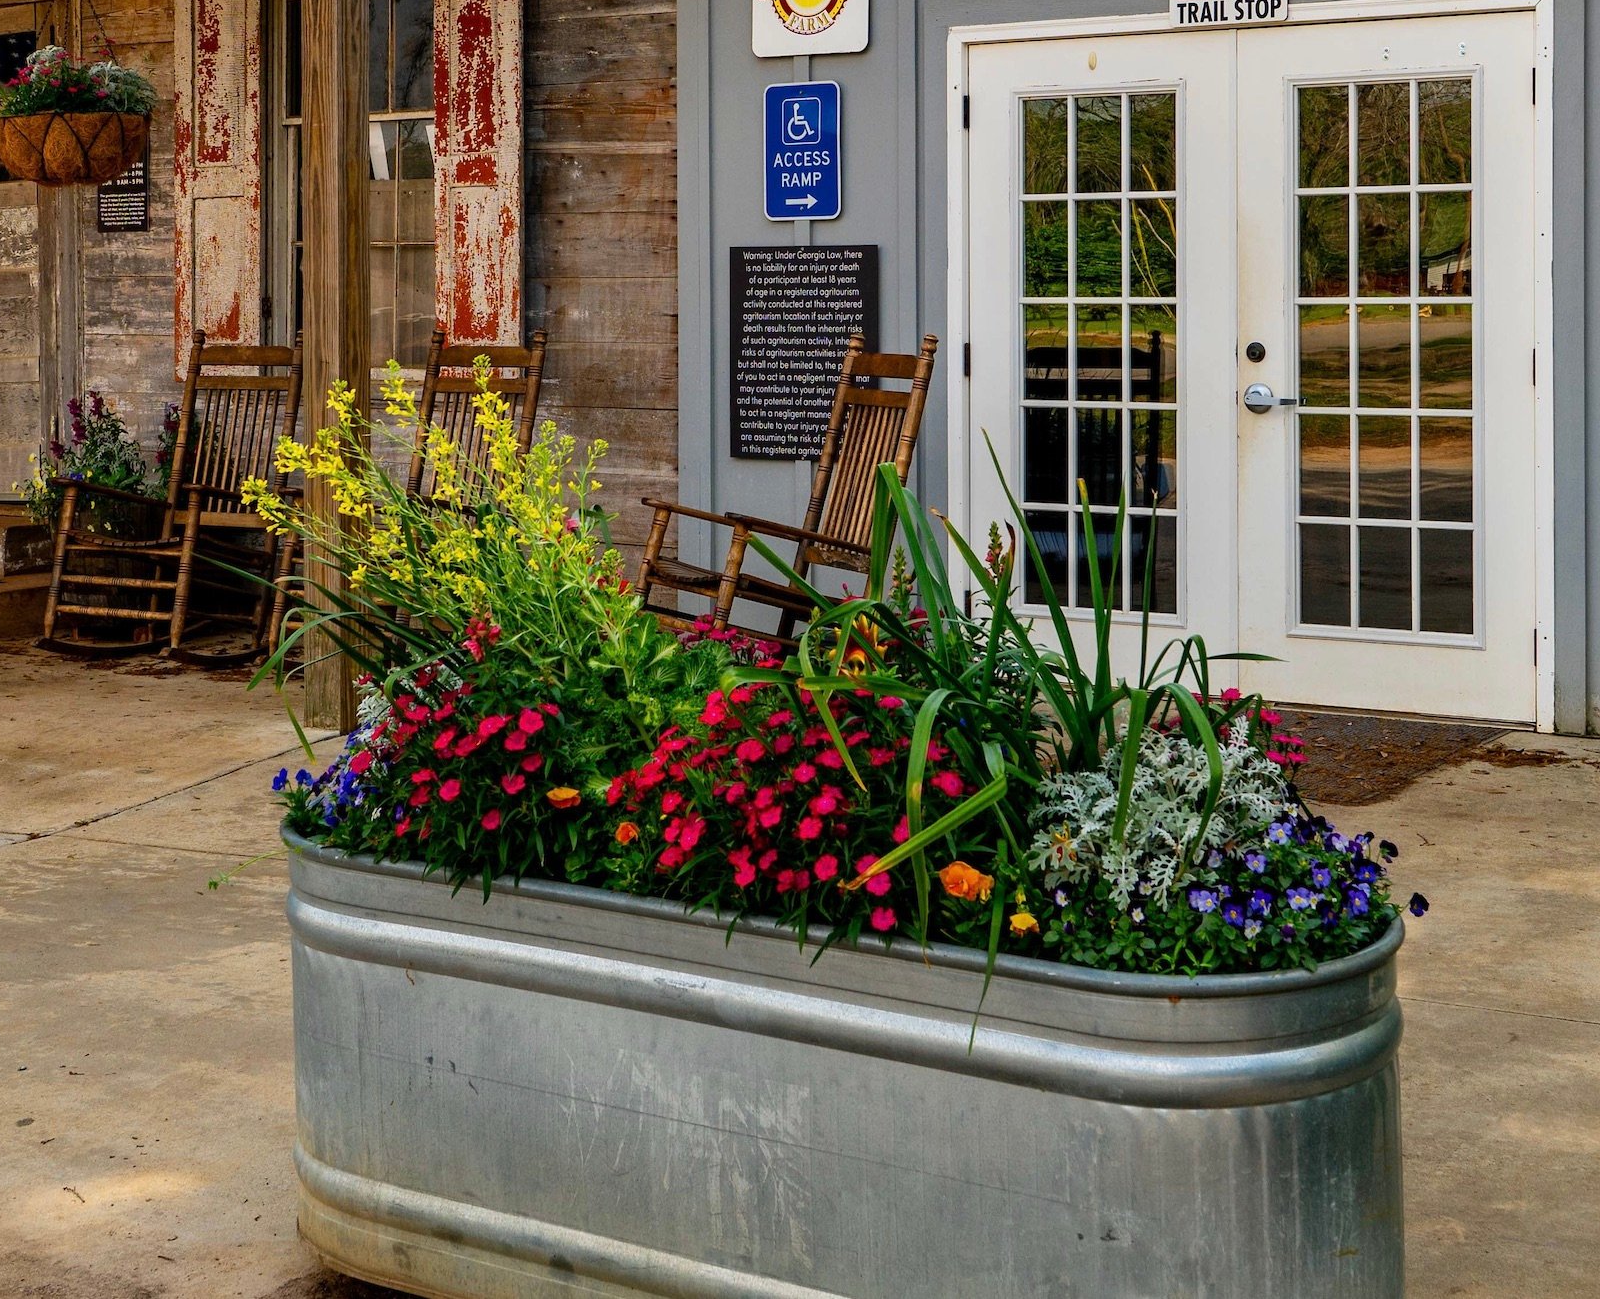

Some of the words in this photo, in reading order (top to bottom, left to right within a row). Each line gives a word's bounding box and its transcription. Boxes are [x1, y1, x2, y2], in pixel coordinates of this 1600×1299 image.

[1177, 1, 1228, 24] TRAIL
[788, 12, 830, 31] FARM
[774, 151, 831, 167] ACCESS
[781, 172, 822, 187] RAMP
[743, 252, 773, 262] Warning:
[775, 251, 796, 259] Under
[797, 251, 825, 261] Georgia
[827, 251, 842, 259] Law,
[844, 250, 862, 258] there
[746, 263, 751, 272] is
[763, 263, 786, 273] liability
[788, 263, 798, 271] for
[810, 263, 828, 273] injury
[839, 263, 859, 271] death
[749, 275, 756, 284] of
[764, 275, 800, 286] participant
[811, 275, 827, 283] least
[829, 275, 836, 283] 18
[837, 277, 856, 285] years
[746, 288, 753, 296] of
[754, 290, 768, 298] age
[784, 288, 818, 298] registered
[819, 288, 859, 298] agritourism
[743, 300, 767, 310] activity
[768, 300, 804, 308] conducted
[814, 300, 826, 308] this
[827, 300, 862, 310] registered
[743, 312, 781, 322] agritourism
[783, 312, 810, 320] location
[812, 312, 816, 320] if
[818, 312, 833, 320] such
[835, 312, 854, 322] injury
[743, 324, 763, 332] death
[765, 324, 786, 332] results
[787, 324, 804, 332] from
[805, 324, 816, 332] the
[818, 324, 846, 333] inherent
[848, 324, 862, 333] risks
[742, 336, 749, 344] of
[751, 336, 766, 344] such
[767, 336, 806, 346] agritourism
[808, 337, 833, 346] activity.
[742, 348, 756, 356] risks
[758, 348, 765, 356] of
[766, 349, 805, 358] agritourism
[806, 349, 836, 357] activities
[738, 360, 749, 368] but
[750, 360, 766, 368] shall
[767, 361, 778, 369] not
[780, 360, 789, 369] be
[790, 361, 813, 369] limited
[815, 362, 823, 370] to,
[825, 361, 836, 369] the
[737, 372, 744, 380] of
[745, 374, 757, 382] you
[759, 373, 766, 381] to
[767, 373, 778, 381] act
[794, 373, 825, 383] negligent
[740, 386, 754, 394] may
[756, 385, 790, 393] contribute
[800, 387, 815, 395] your
[816, 386, 835, 396] injury
[737, 396, 750, 404] and
[752, 396, 762, 405] the
[764, 397, 793, 406] potential
[795, 397, 802, 405] of
[803, 398, 830, 406] another
[748, 409, 758, 417] act
[774, 409, 806, 420] negligent
[740, 421, 774, 429] contribute
[800, 422, 819, 432] injury
[754, 434, 786, 444] assuming
[788, 434, 798, 442] the
[800, 434, 811, 442] risk
[813, 434, 820, 443] of
[750, 445, 761, 453] this
[762, 446, 796, 456] registered
[798, 447, 822, 456] agritou
